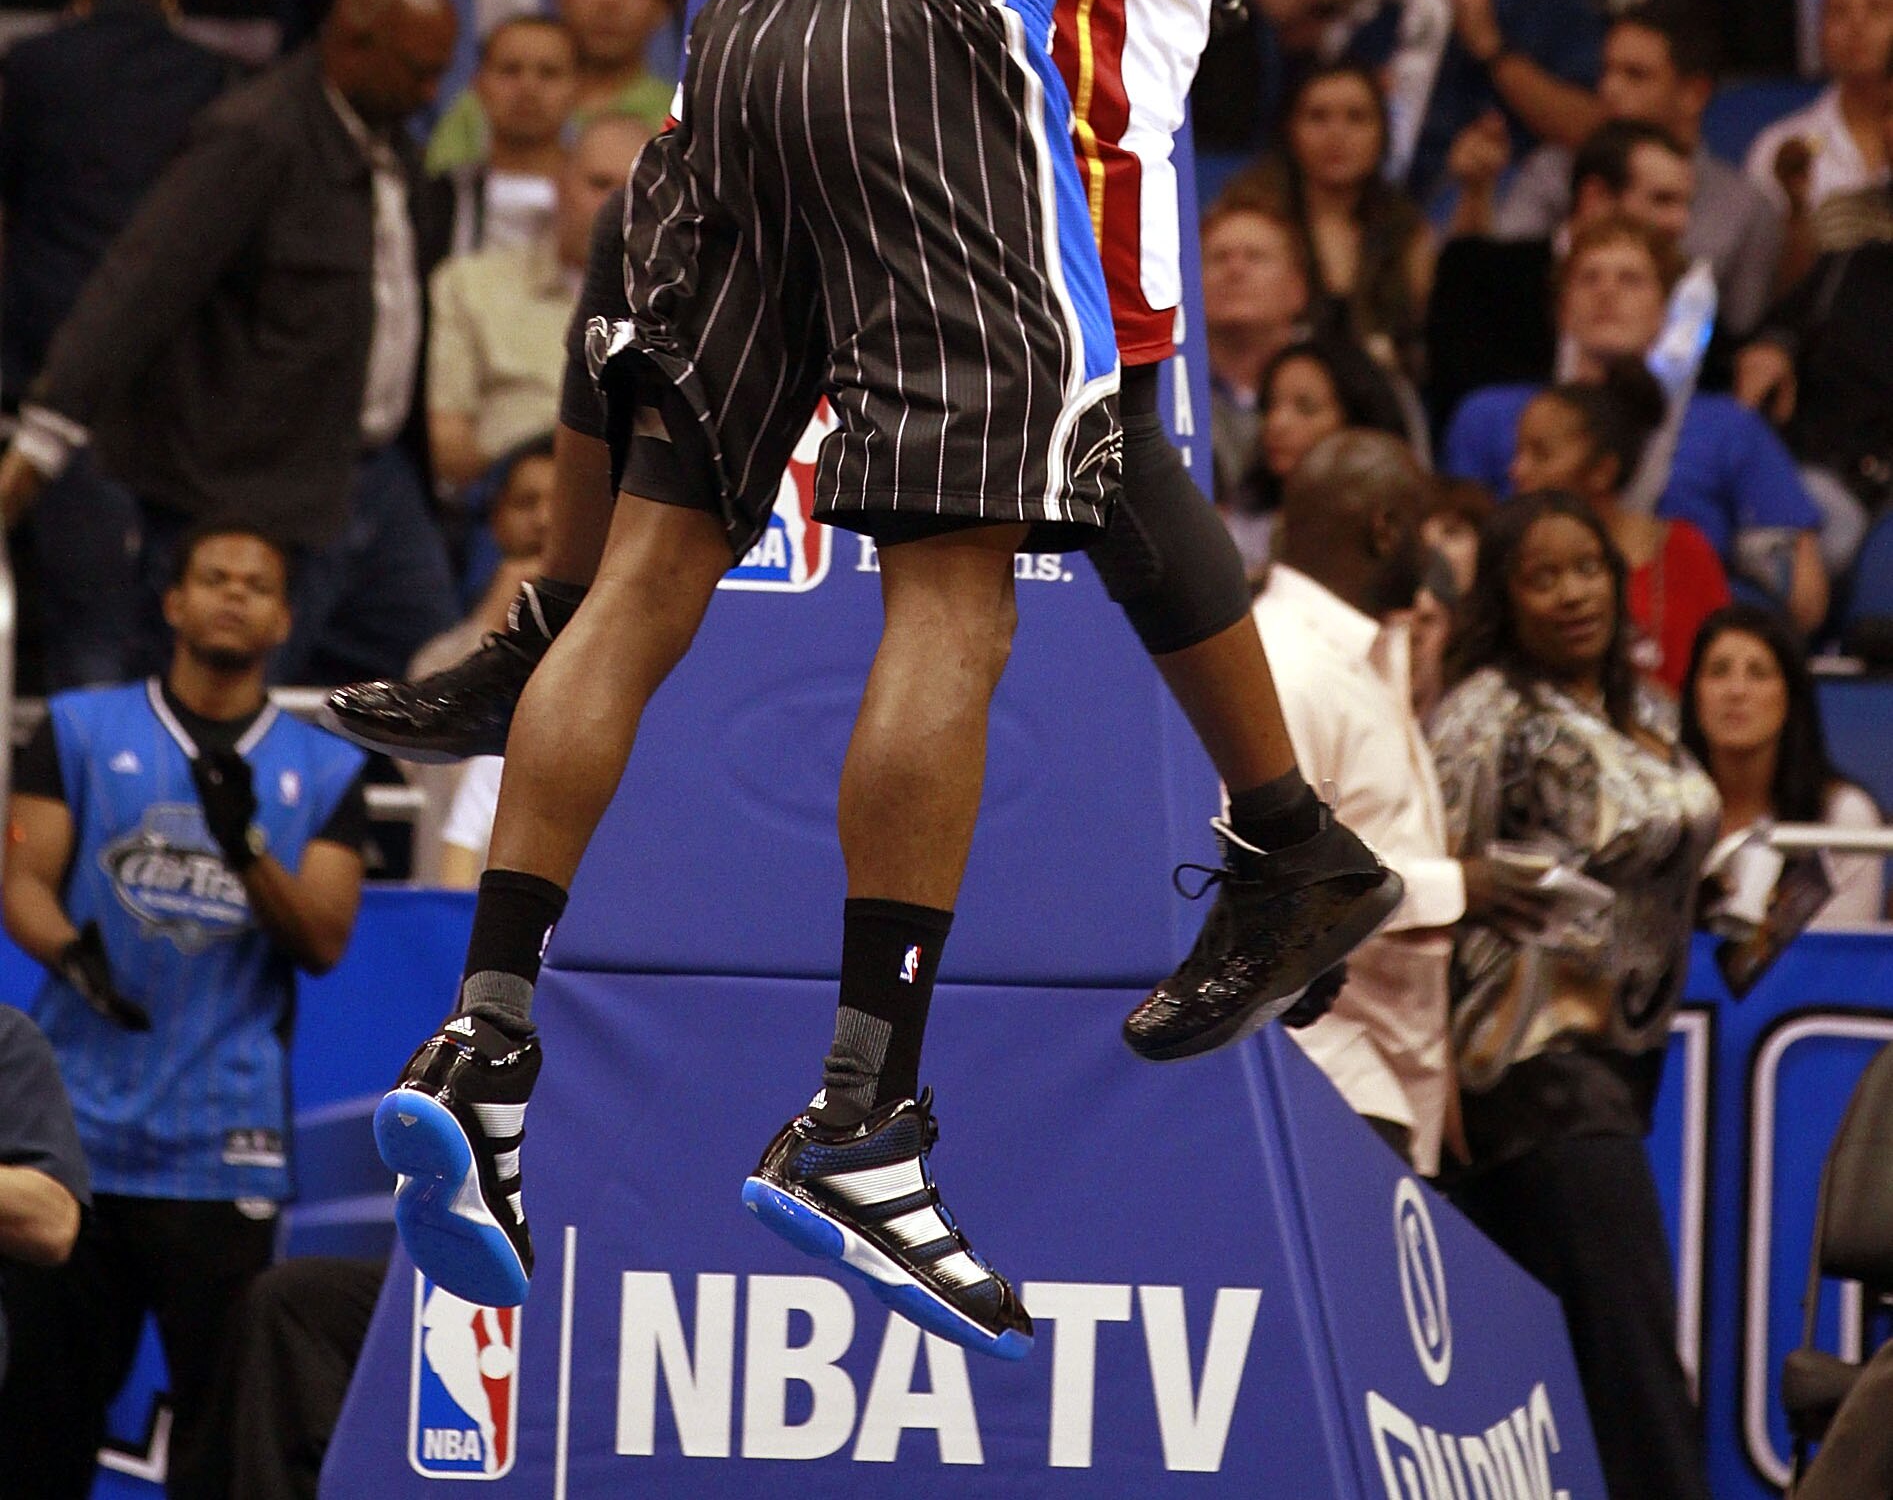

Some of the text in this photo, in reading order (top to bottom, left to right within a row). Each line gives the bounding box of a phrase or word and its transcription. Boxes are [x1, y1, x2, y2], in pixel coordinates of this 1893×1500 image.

[616, 1270, 985, 1466] NBA
[1024, 1280, 1262, 1472] TV
[424, 1428, 482, 1461] NBA
